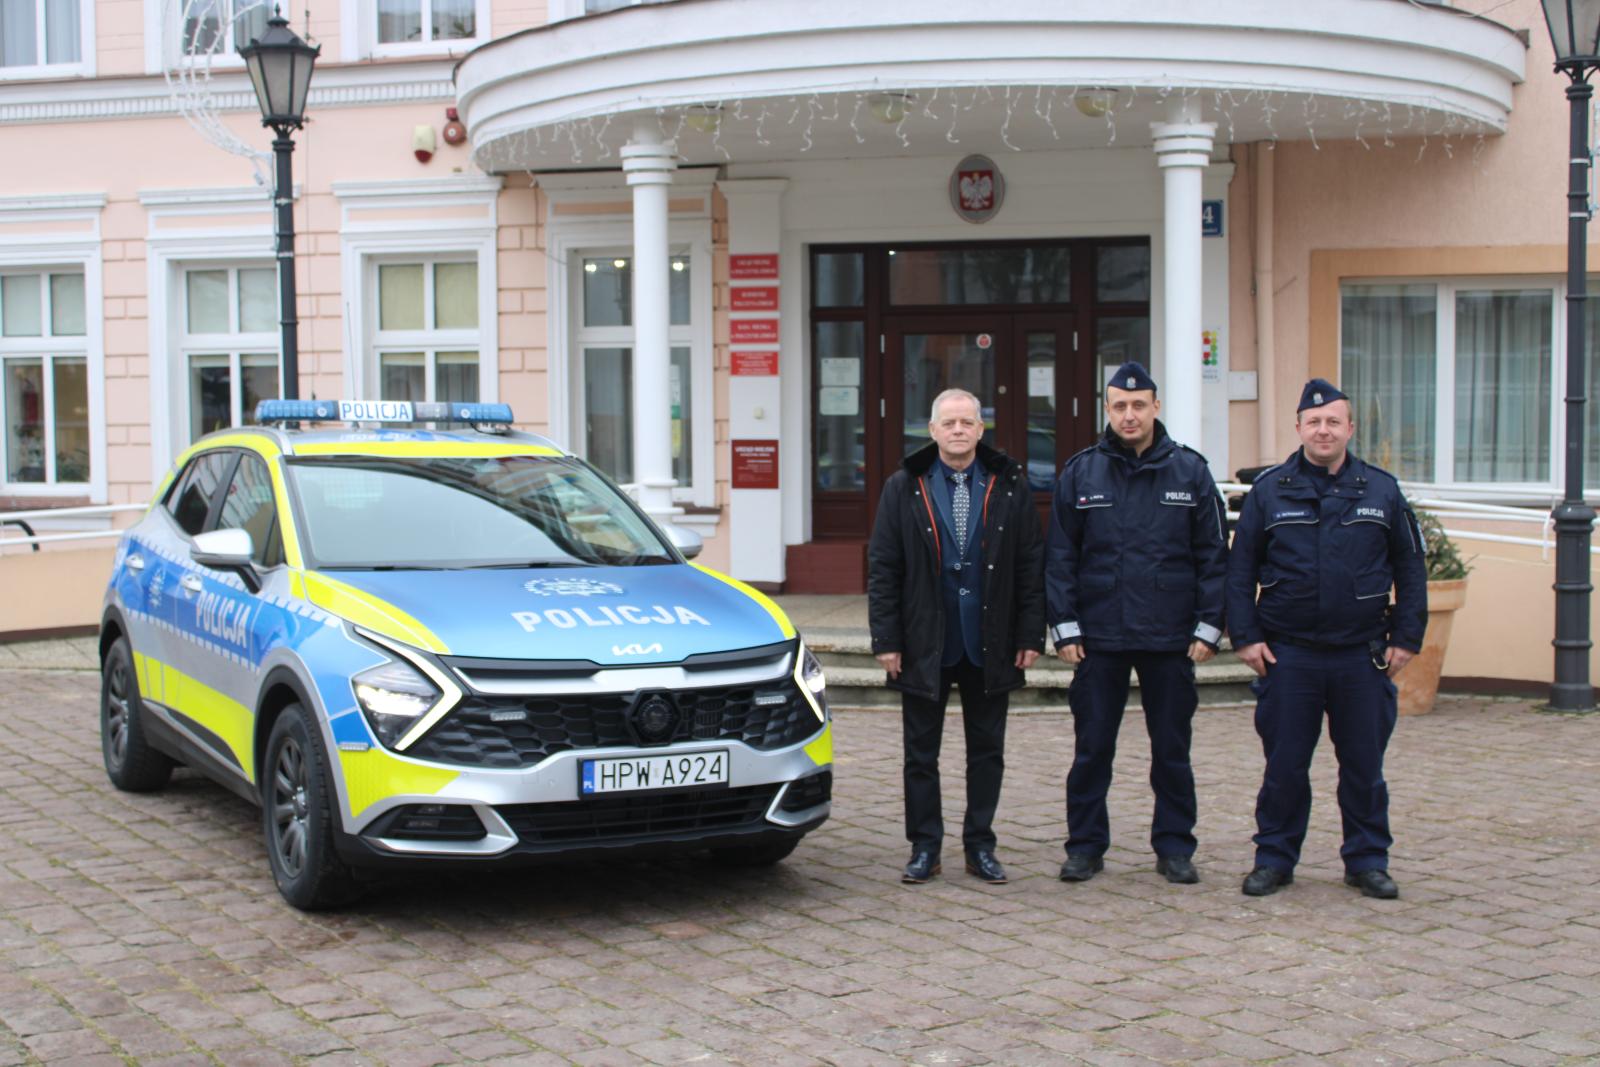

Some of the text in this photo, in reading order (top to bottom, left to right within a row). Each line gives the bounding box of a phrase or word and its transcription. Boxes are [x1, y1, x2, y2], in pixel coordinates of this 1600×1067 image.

[1203, 206, 1214, 224] 4
[341, 402, 410, 419] POLICJA
[1165, 491, 1192, 501] POLICJA
[1356, 507, 1385, 518] POLICJA
[196, 589, 252, 649] POLICJA
[511, 605, 711, 633] POLICJA
[601, 754, 722, 790] HPW A924
[583, 781, 594, 789] PL
